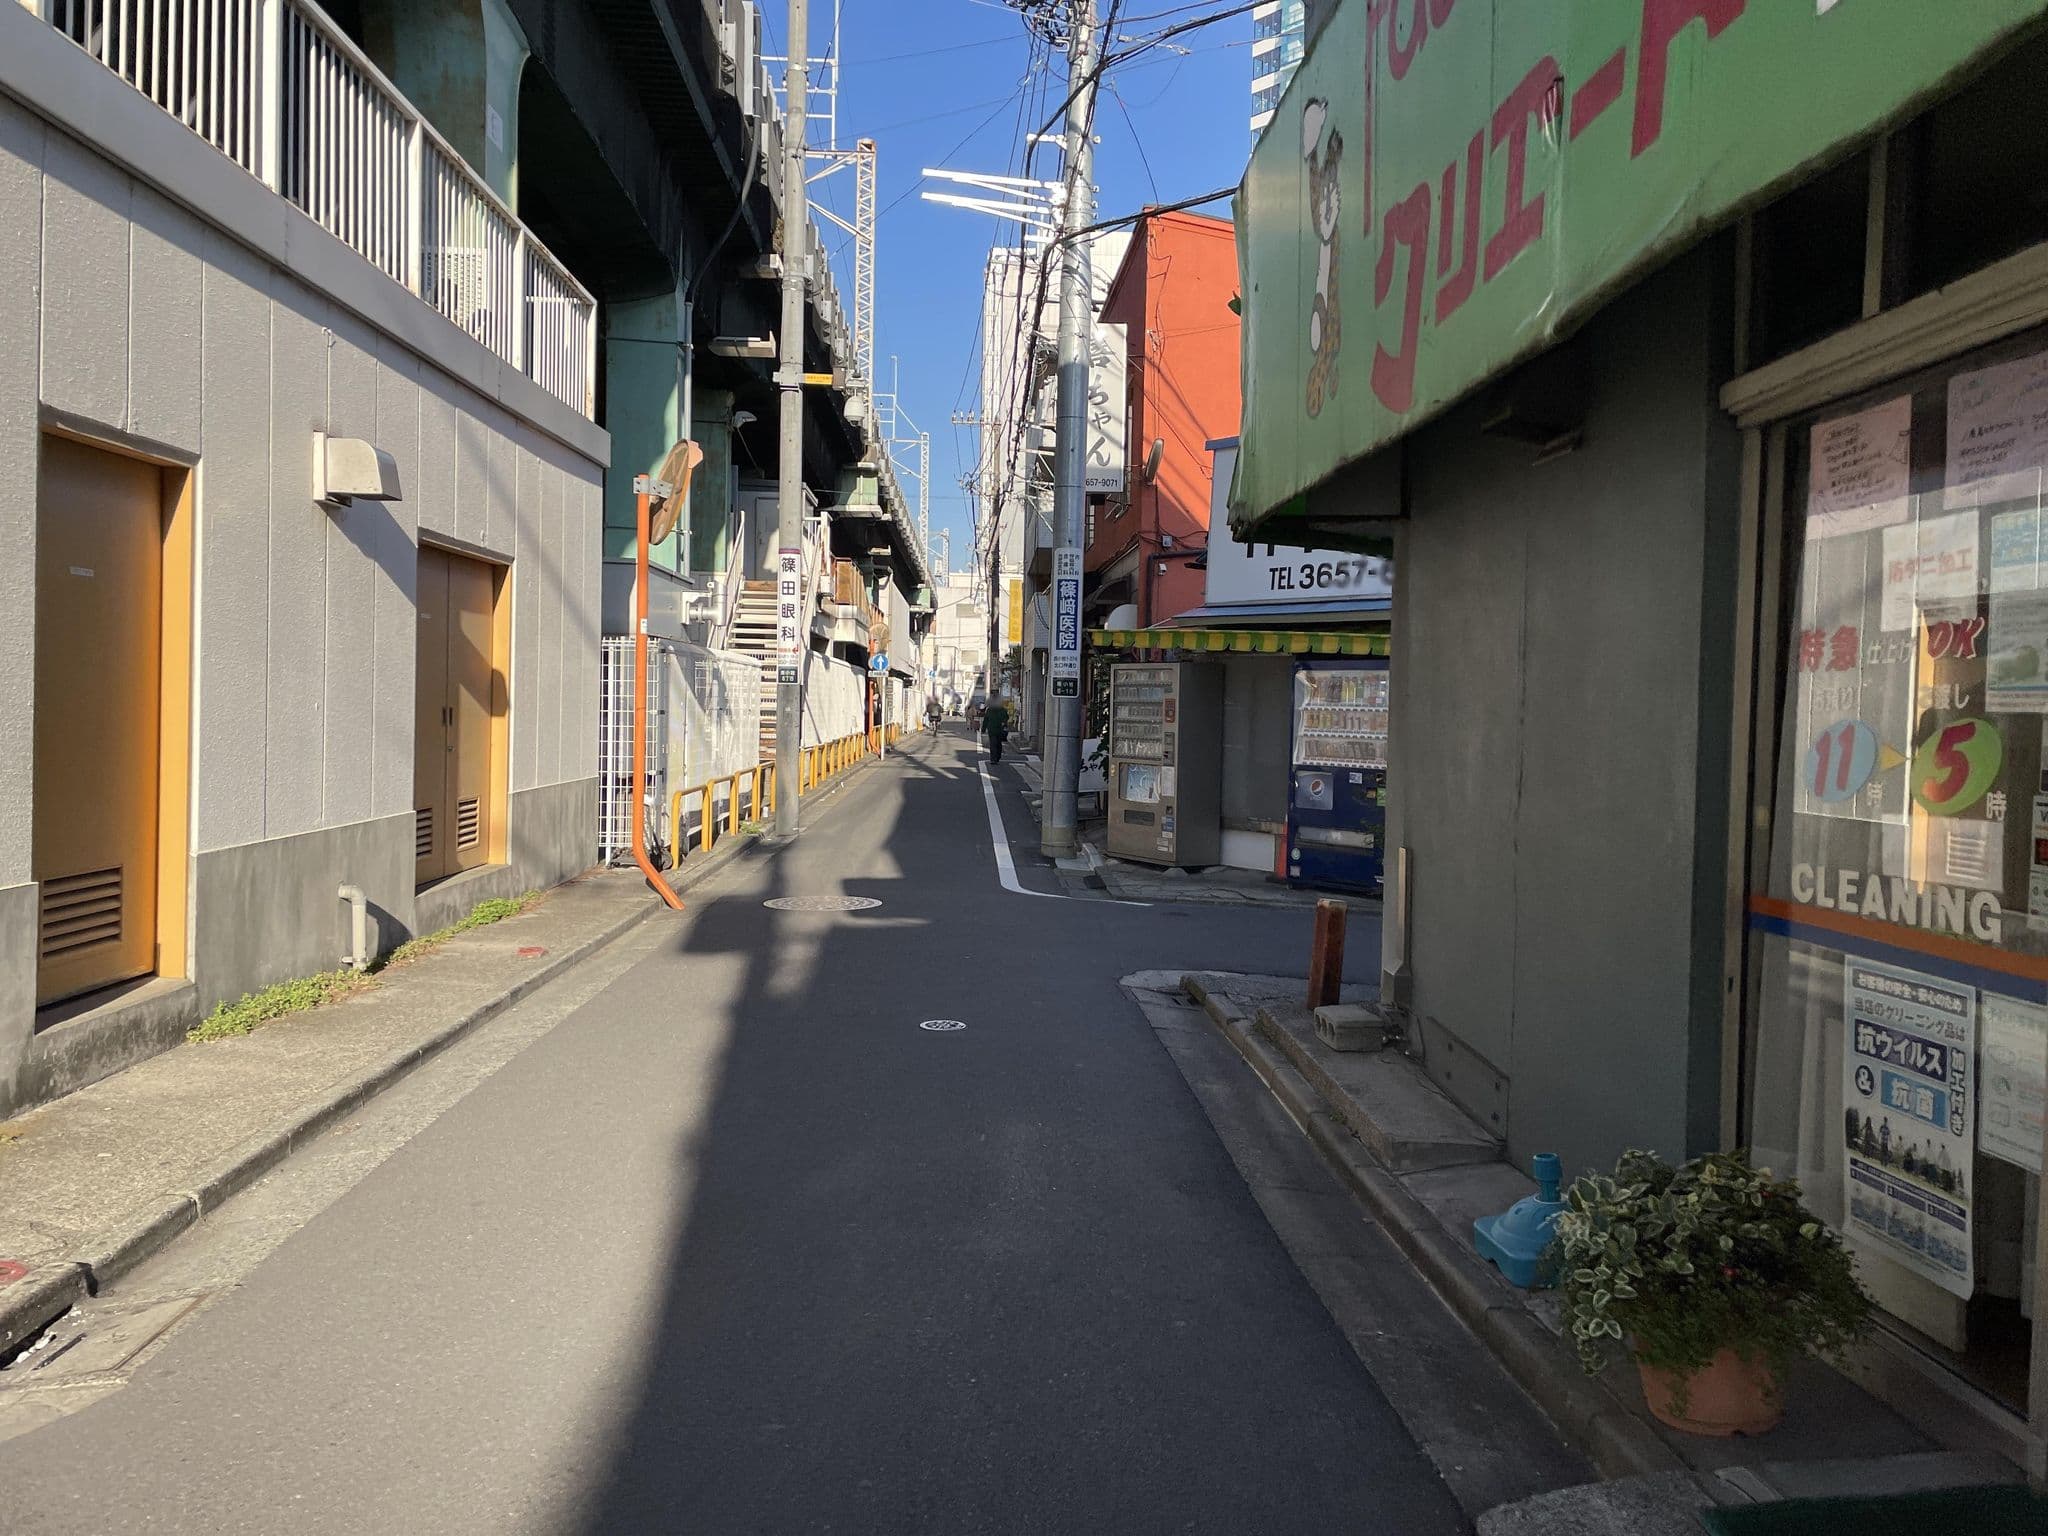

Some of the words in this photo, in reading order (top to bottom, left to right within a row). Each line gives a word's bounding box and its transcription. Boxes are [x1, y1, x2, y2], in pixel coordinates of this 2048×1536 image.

[781, 557, 796, 642] 篠田眼科
[1269, 566, 1295, 590] TEL
[1798, 625, 1860, 673] 特急
[1926, 617, 1984, 660] OK
[1814, 723, 1857, 798] 11
[1920, 721, 1977, 804] 5
[1986, 790, 2008, 821] 時
[1791, 861, 2002, 943] CLEANING
[1854, 996, 1966, 1042] 当店のクリーニング品は
[1857, 1023, 1943, 1076] 抗ウイルス
[1857, 1066, 1872, 1092] &
[1891, 1078, 1934, 1121] 抗菌
